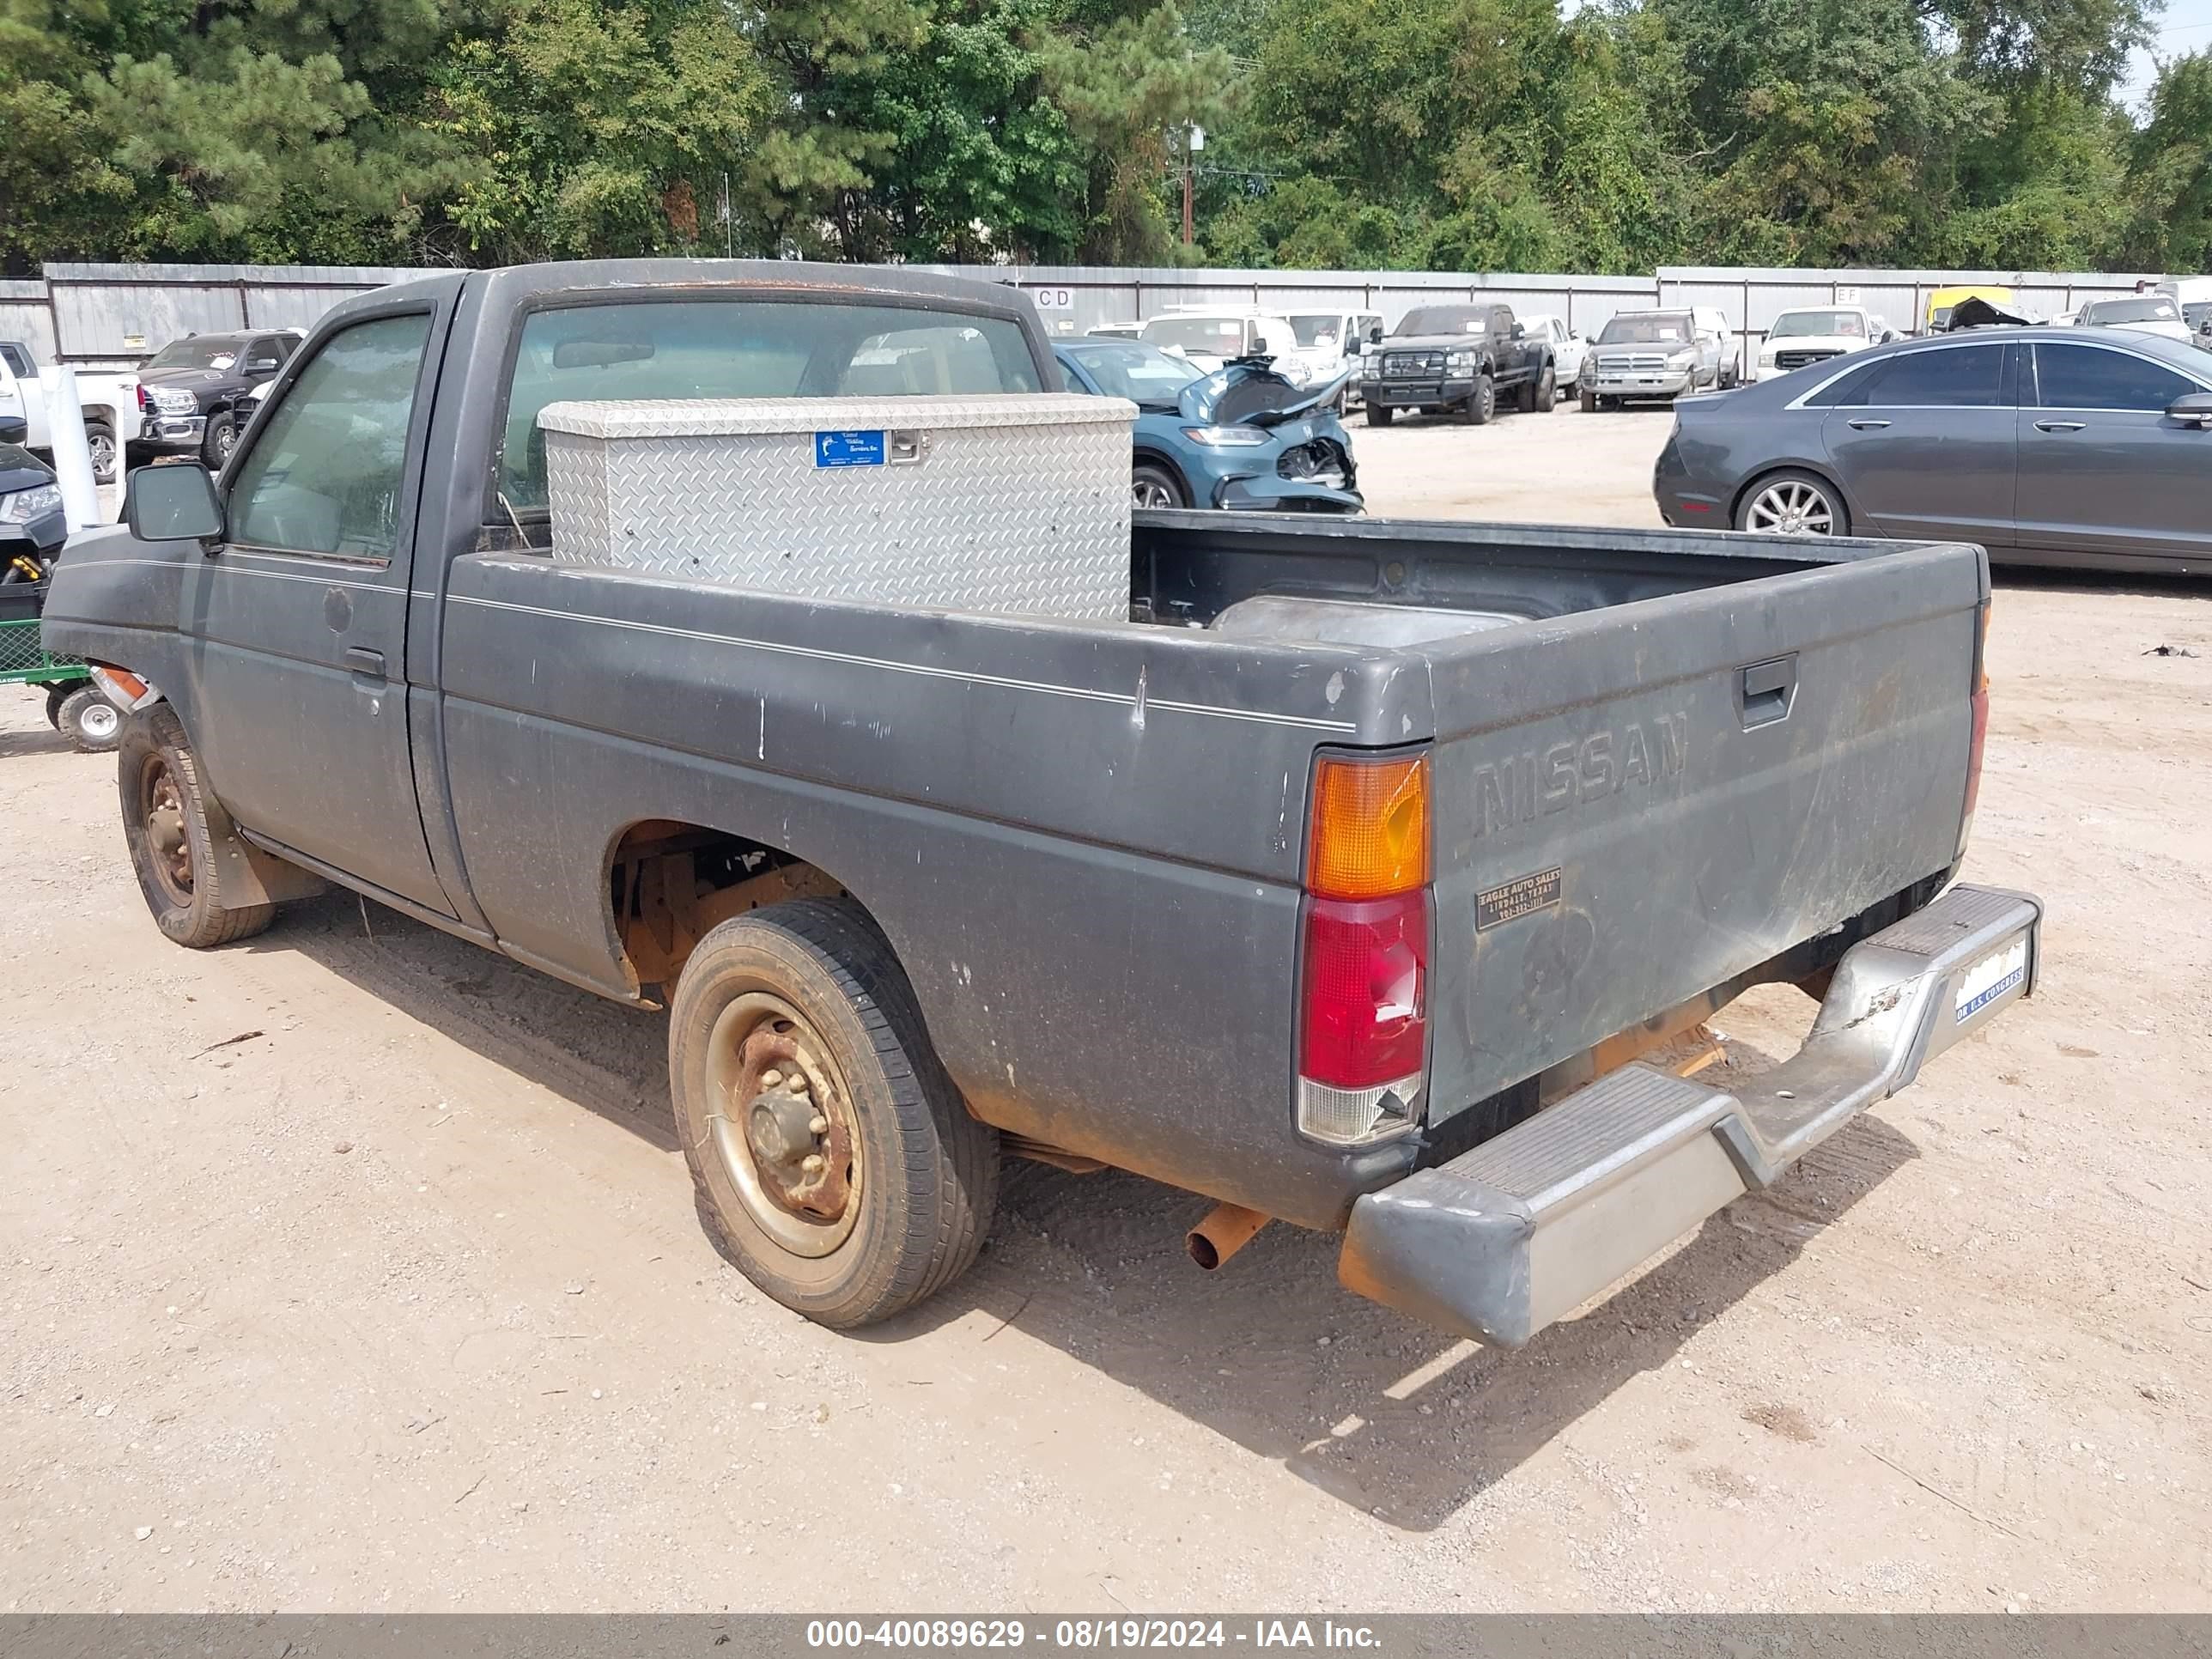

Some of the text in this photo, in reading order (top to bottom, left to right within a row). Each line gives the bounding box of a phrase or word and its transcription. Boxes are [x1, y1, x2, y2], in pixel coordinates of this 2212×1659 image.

[1473, 711, 1688, 838] NISSAN
[1479, 870, 1560, 906] EAGLE AUTO SALES
[1528, 883, 1553, 899] TEXAS
[1957, 1006, 1968, 1020] OR
[1985, 968, 2022, 1001] CONGRESS
